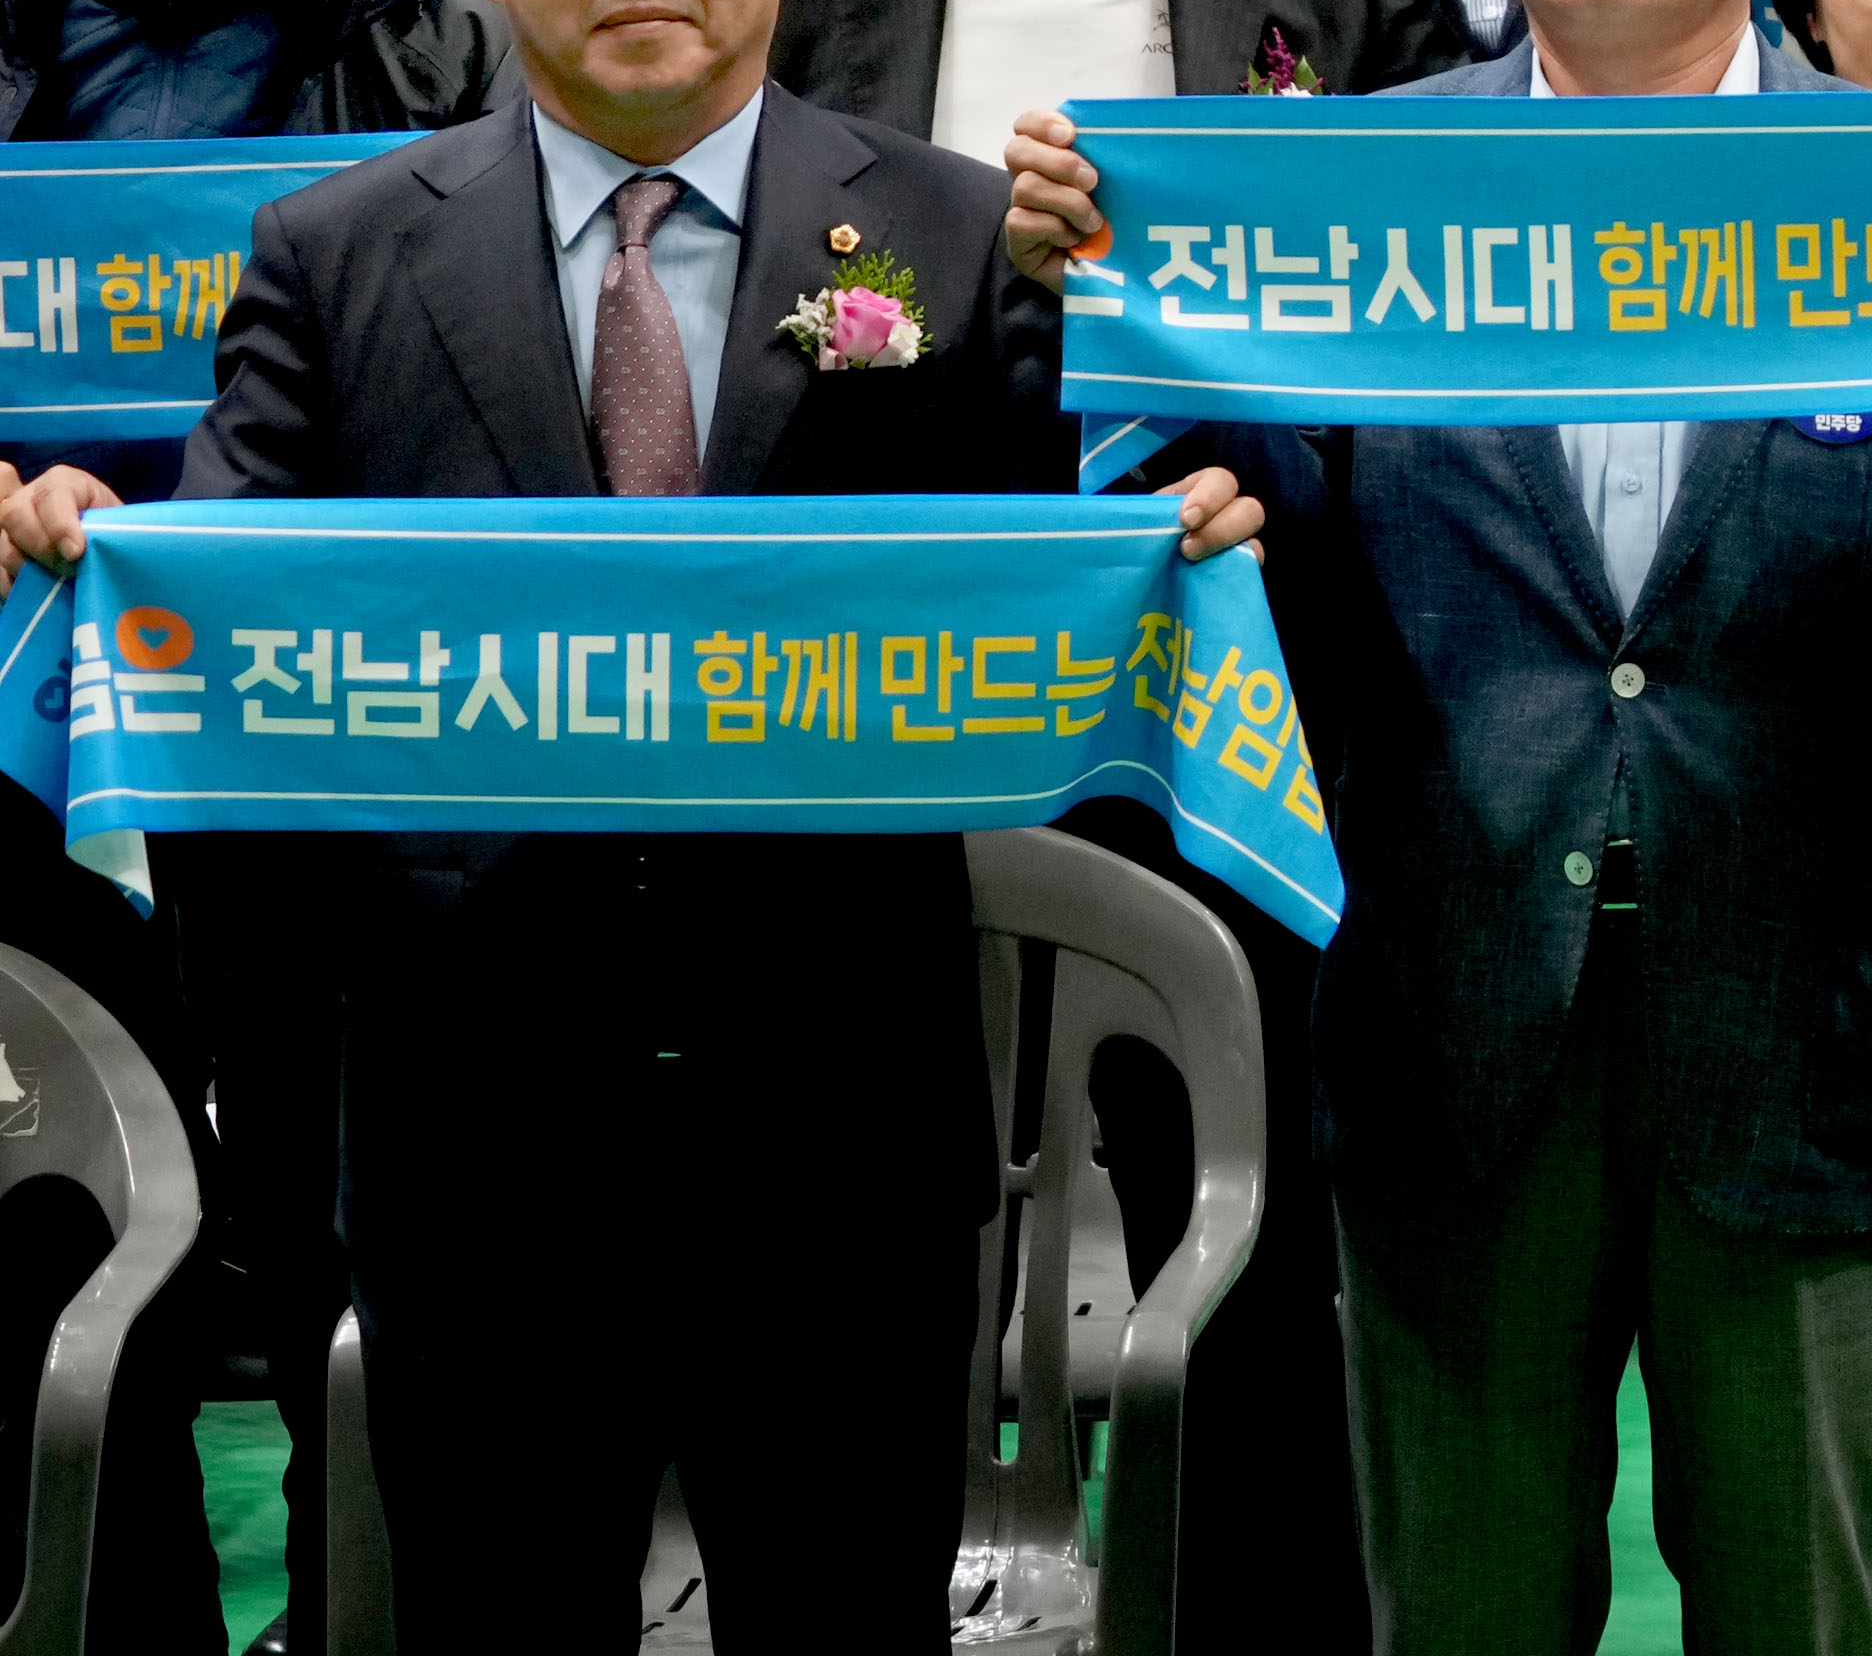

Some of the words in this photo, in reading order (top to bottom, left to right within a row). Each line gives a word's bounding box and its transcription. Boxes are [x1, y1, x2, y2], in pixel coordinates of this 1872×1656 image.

[96, 251, 241, 354] 함께
[1146, 223, 1573, 332] 전남시대
[1593, 220, 1758, 330] 함께
[1813, 412, 1863, 433] 민주당
[229, 627, 671, 741] 전남시대
[692, 630, 859, 744] 함께
[879, 630, 1118, 744] 만드는
